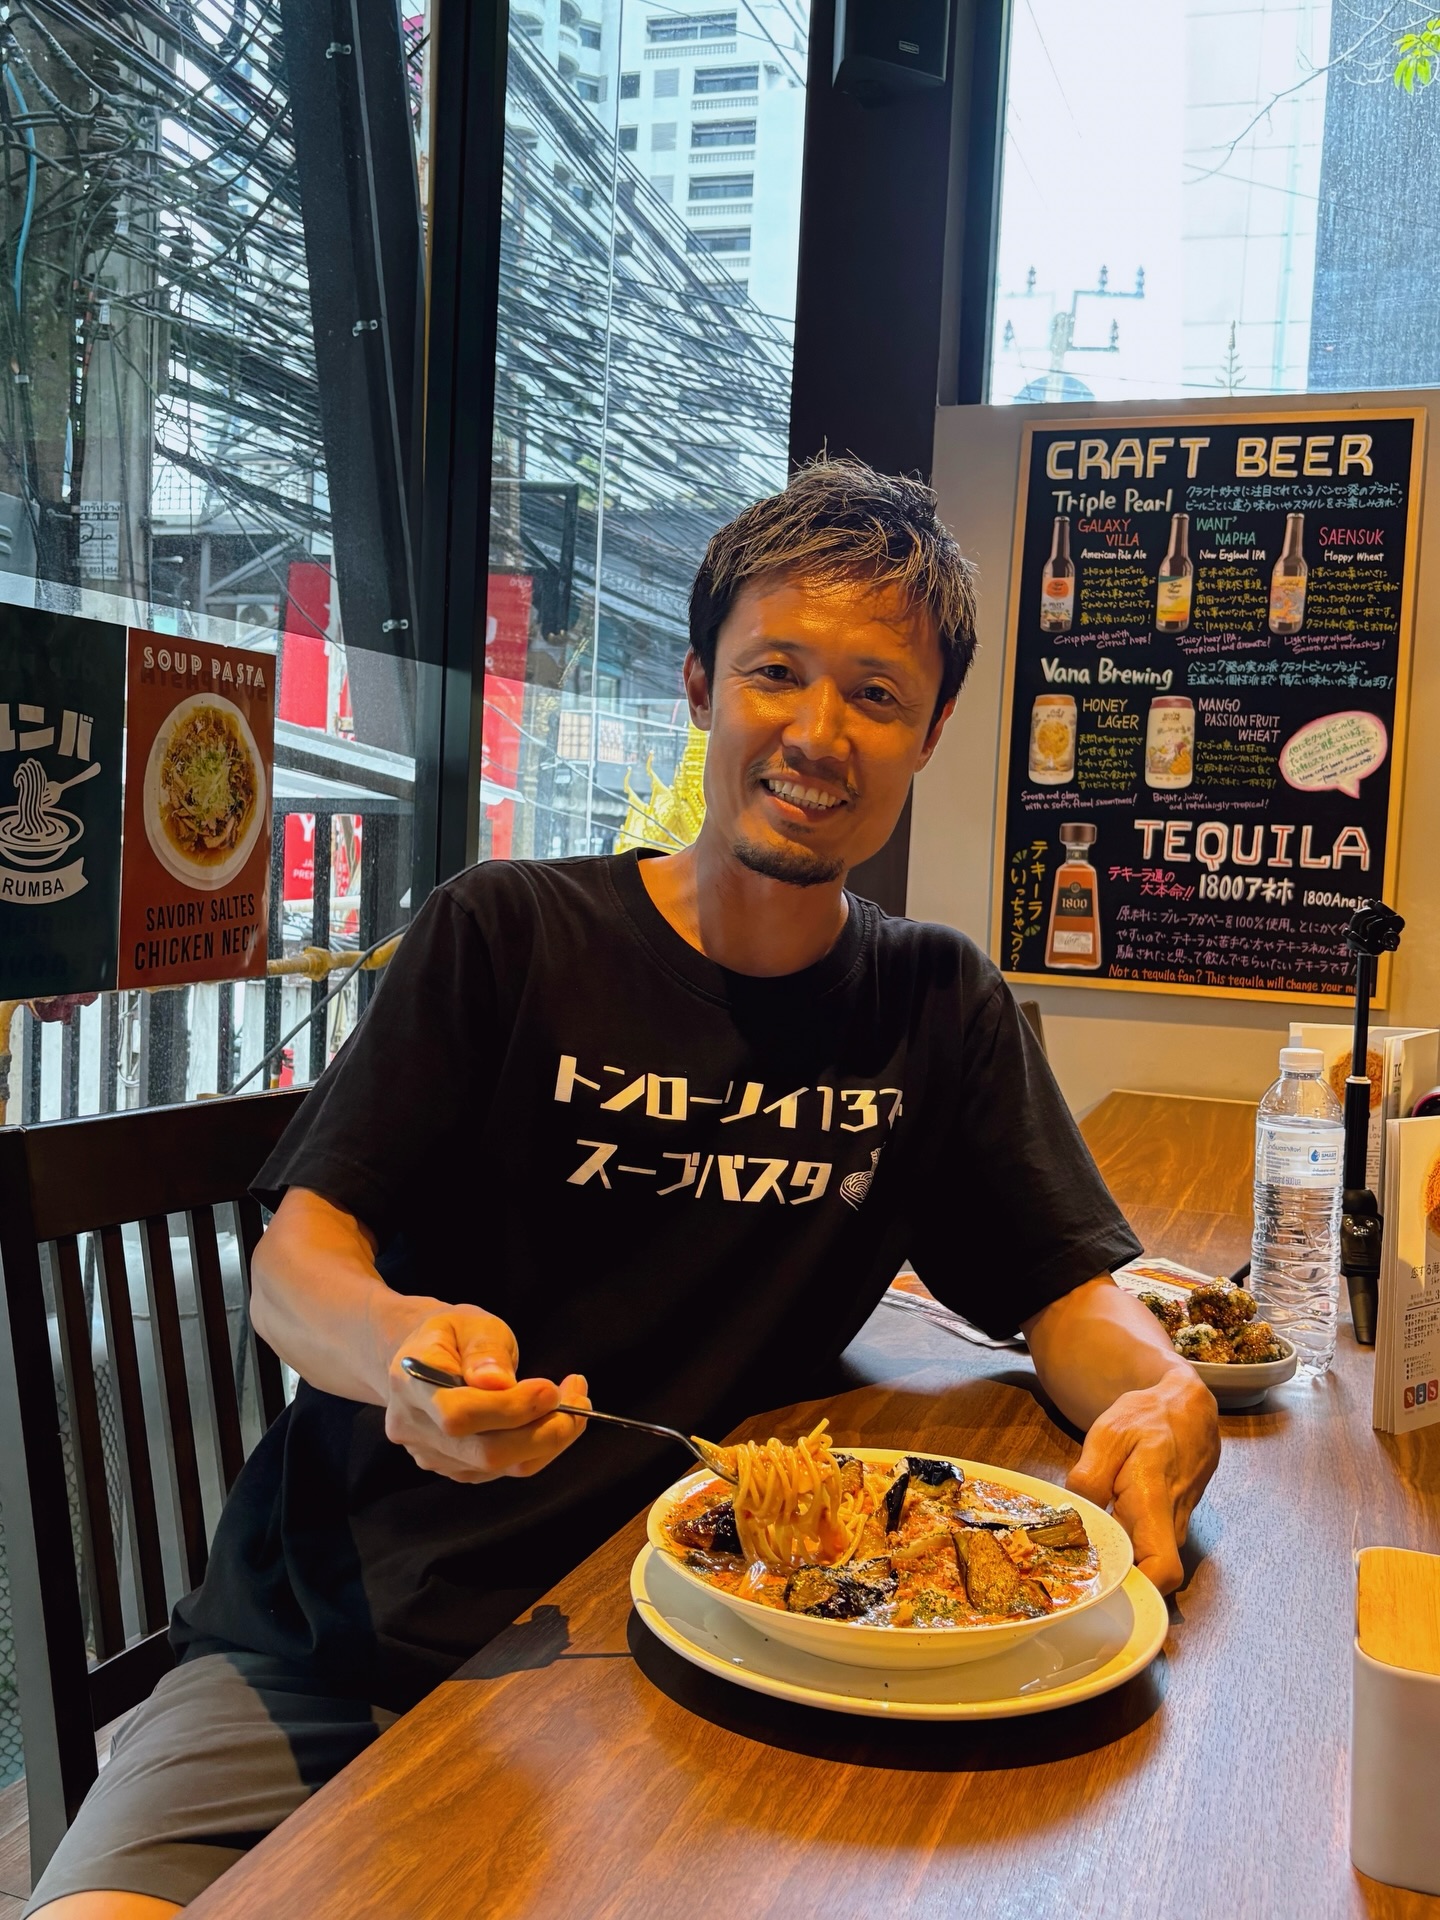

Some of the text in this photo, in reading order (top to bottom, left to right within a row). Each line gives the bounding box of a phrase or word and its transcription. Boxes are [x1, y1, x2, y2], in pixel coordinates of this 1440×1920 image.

[1046, 434, 1374, 480] CRAFT BEER
[1052, 488, 1173, 517] Triple Pearl
[1078, 518, 1131, 533] GALAXY
[1106, 533, 1140, 547] VILLA
[1215, 532, 1256, 546] NAPHA
[1319, 527, 1384, 546] SAENSUK
[1133, 549, 1147, 560] Ale
[1199, 549, 1265, 562] New England IPA
[1324, 551, 1384, 564] Hoppy Wheat
[143, 646, 266, 690] SOUP PASTA
[1041, 657, 1173, 690] Vana Brewing
[1082, 698, 1129, 713] HONEY
[1198, 697, 1240, 712] MANGO
[1097, 714, 1140, 730] LAGER
[1204, 713, 1280, 728] PASSION FRUIT
[1238, 729, 1280, 743] WHEAT
[1134, 819, 1370, 872] TEQUILA
[2, 878, 65, 898] RUMBA
[1028, 840, 1048, 921] テキーラ
[1199, 874, 1296, 906] 1800アネホ
[146, 893, 255, 931] SAVORY SALTES
[134, 931, 214, 970] CHICKEN
[1108, 963, 1130, 979] Not
[1131, 968, 1139, 979] a
[1142, 969, 1176, 983] tequila
[1177, 969, 1202, 983] fan?
[1205, 970, 1225, 984] This
[1228, 974, 1265, 989] tequila
[1267, 977, 1284, 989] will
[1286, 979, 1318, 993] change
[1321, 982, 1343, 995] your
